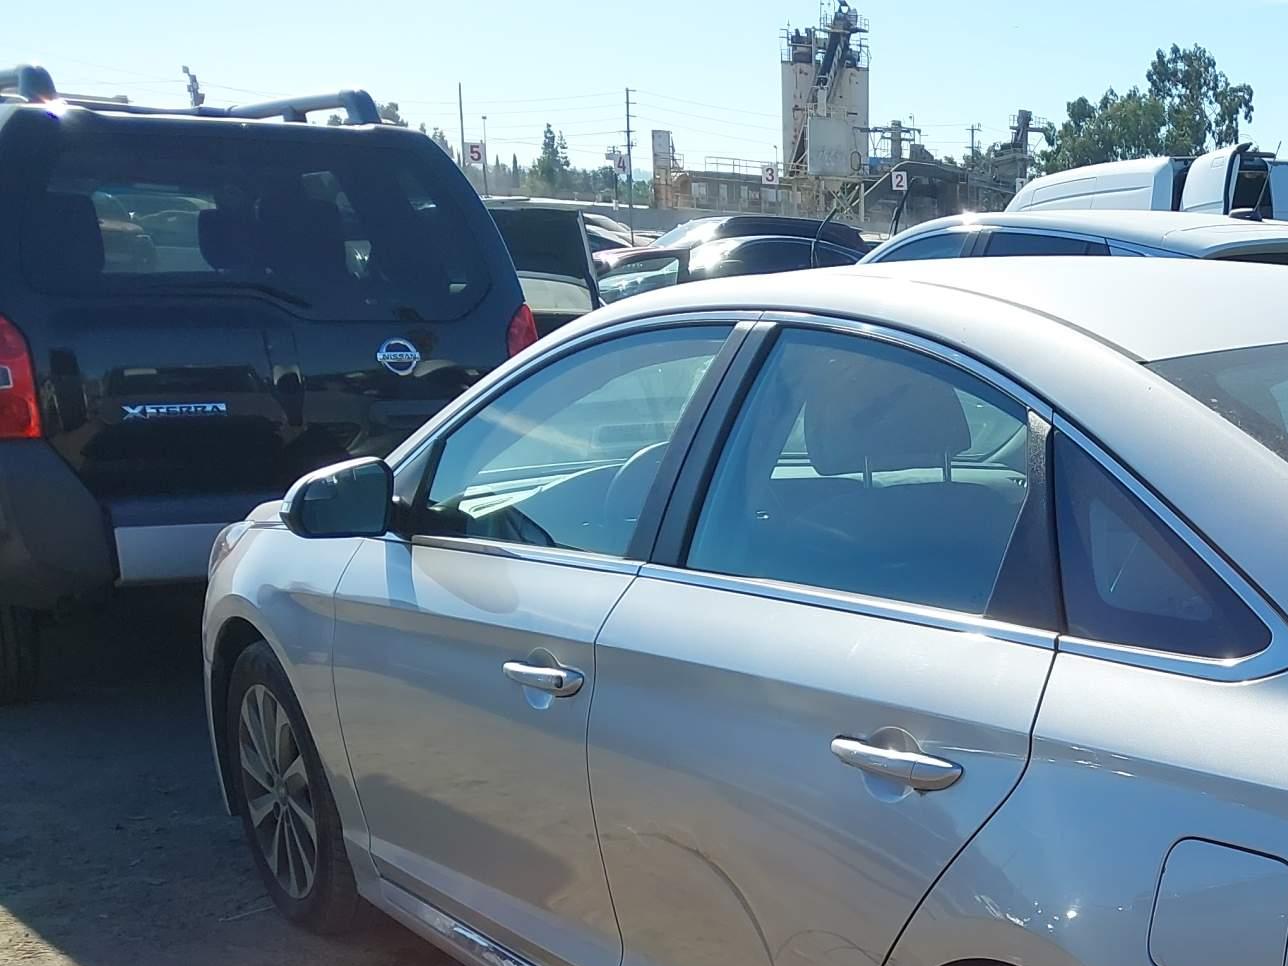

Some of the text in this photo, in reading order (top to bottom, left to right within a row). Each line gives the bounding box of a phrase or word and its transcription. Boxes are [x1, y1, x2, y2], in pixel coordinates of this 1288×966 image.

[470, 145, 482, 161] 5
[617, 155, 627, 172] 4
[765, 168, 775, 183] 3
[895, 174, 905, 188] 2
[377, 352, 420, 362] NISSAN
[122, 403, 227, 419] XTERRA
